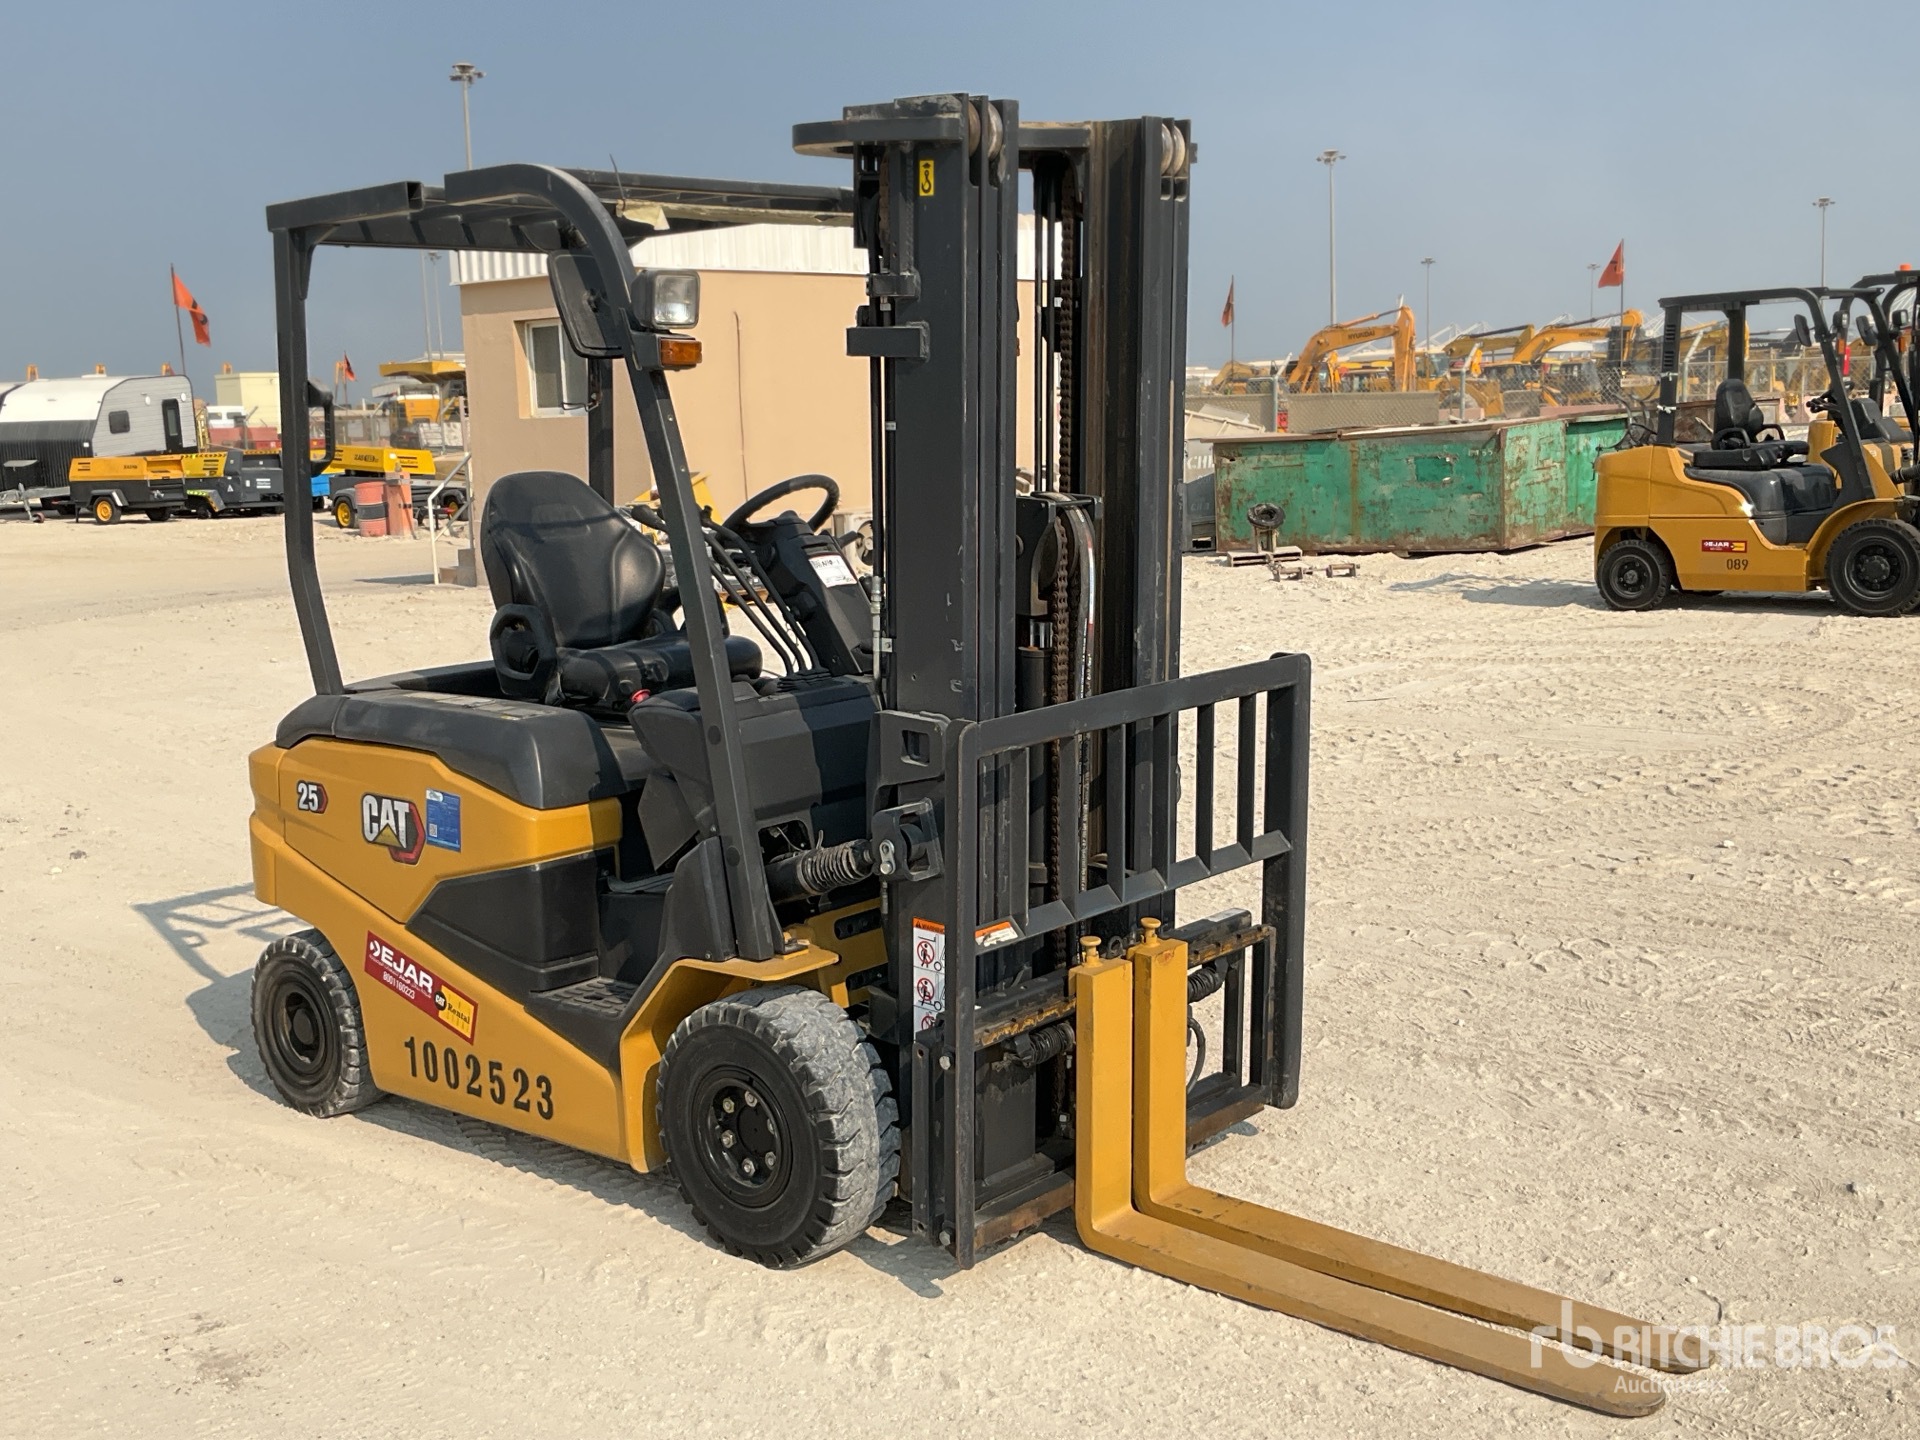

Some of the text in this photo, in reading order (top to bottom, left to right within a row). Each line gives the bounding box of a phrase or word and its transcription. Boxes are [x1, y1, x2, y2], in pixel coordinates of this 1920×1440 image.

[1347, 330, 1376, 340] HYUNDAI
[1726, 558, 1749, 571] 089
[297, 782, 319, 811] 25
[362, 794, 410, 849] CAT
[381, 945, 433, 994] EJAR
[435, 994, 471, 1025] CAT Rental
[404, 1036, 554, 1120] 1002523
